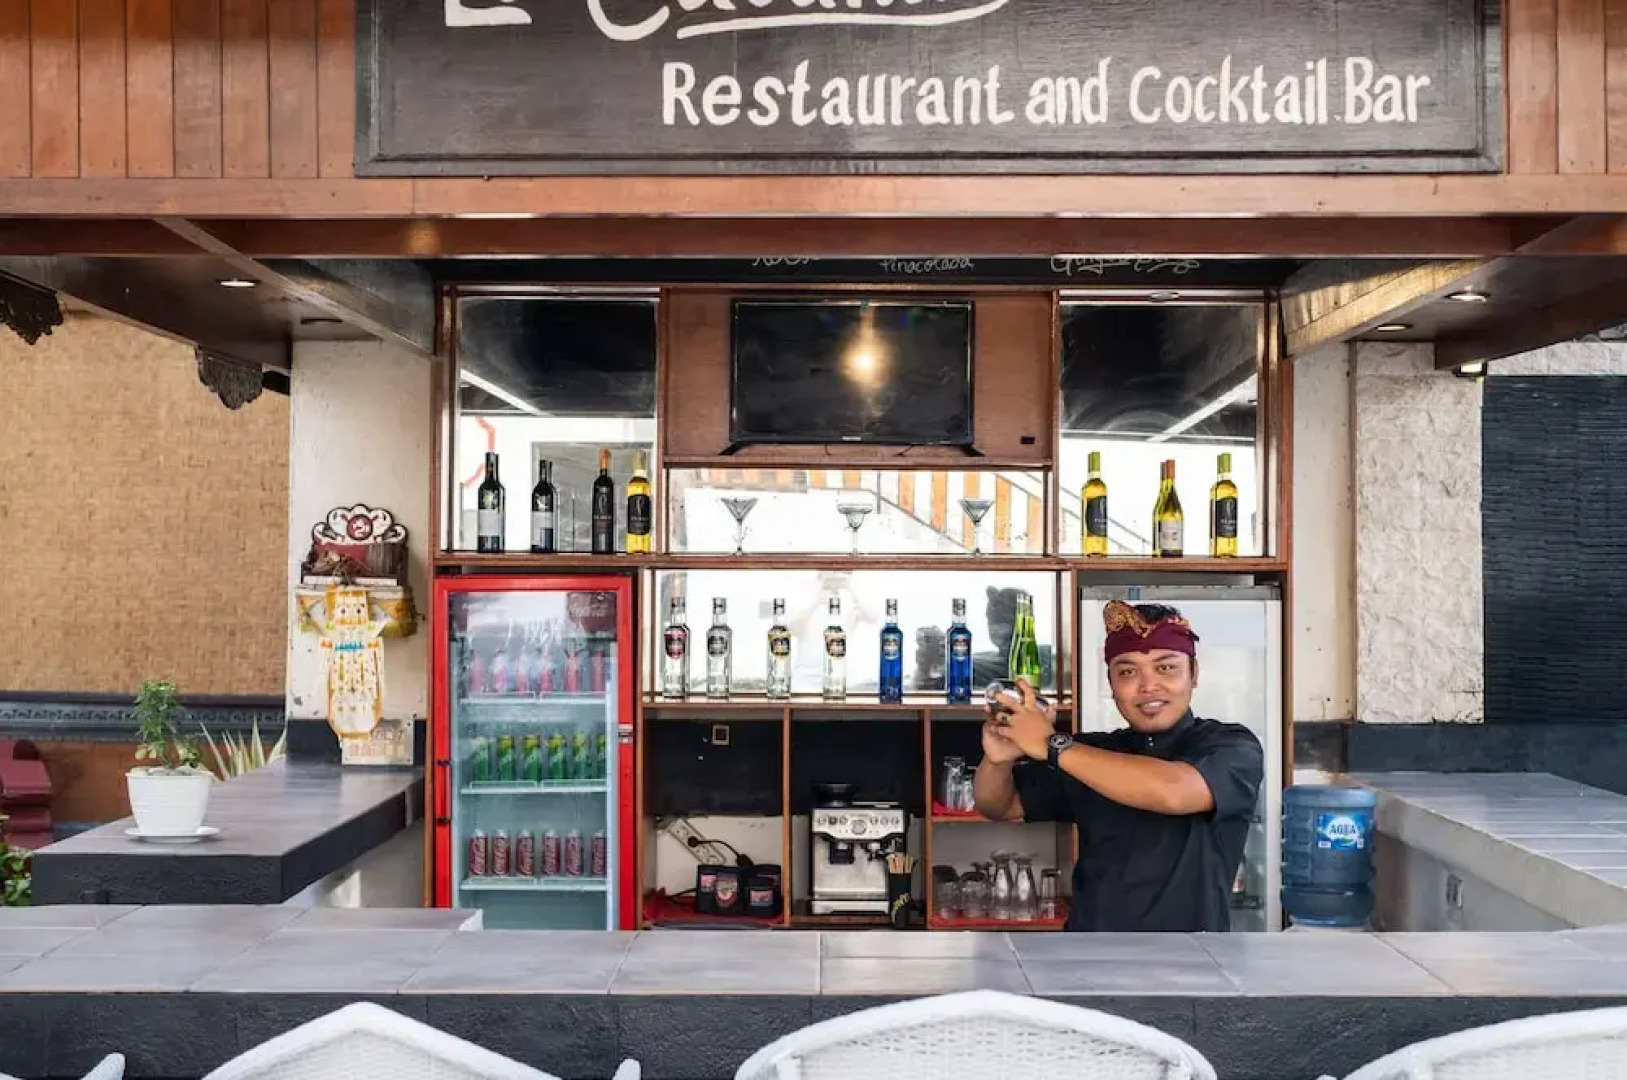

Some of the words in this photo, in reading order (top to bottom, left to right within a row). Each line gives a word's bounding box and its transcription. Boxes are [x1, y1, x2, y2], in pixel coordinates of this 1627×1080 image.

[661, 59, 1014, 128] Restaurant
[1025, 56, 1111, 126] and
[1129, 54, 1328, 126] Cocktail
[1343, 56, 1431, 125] Bar
